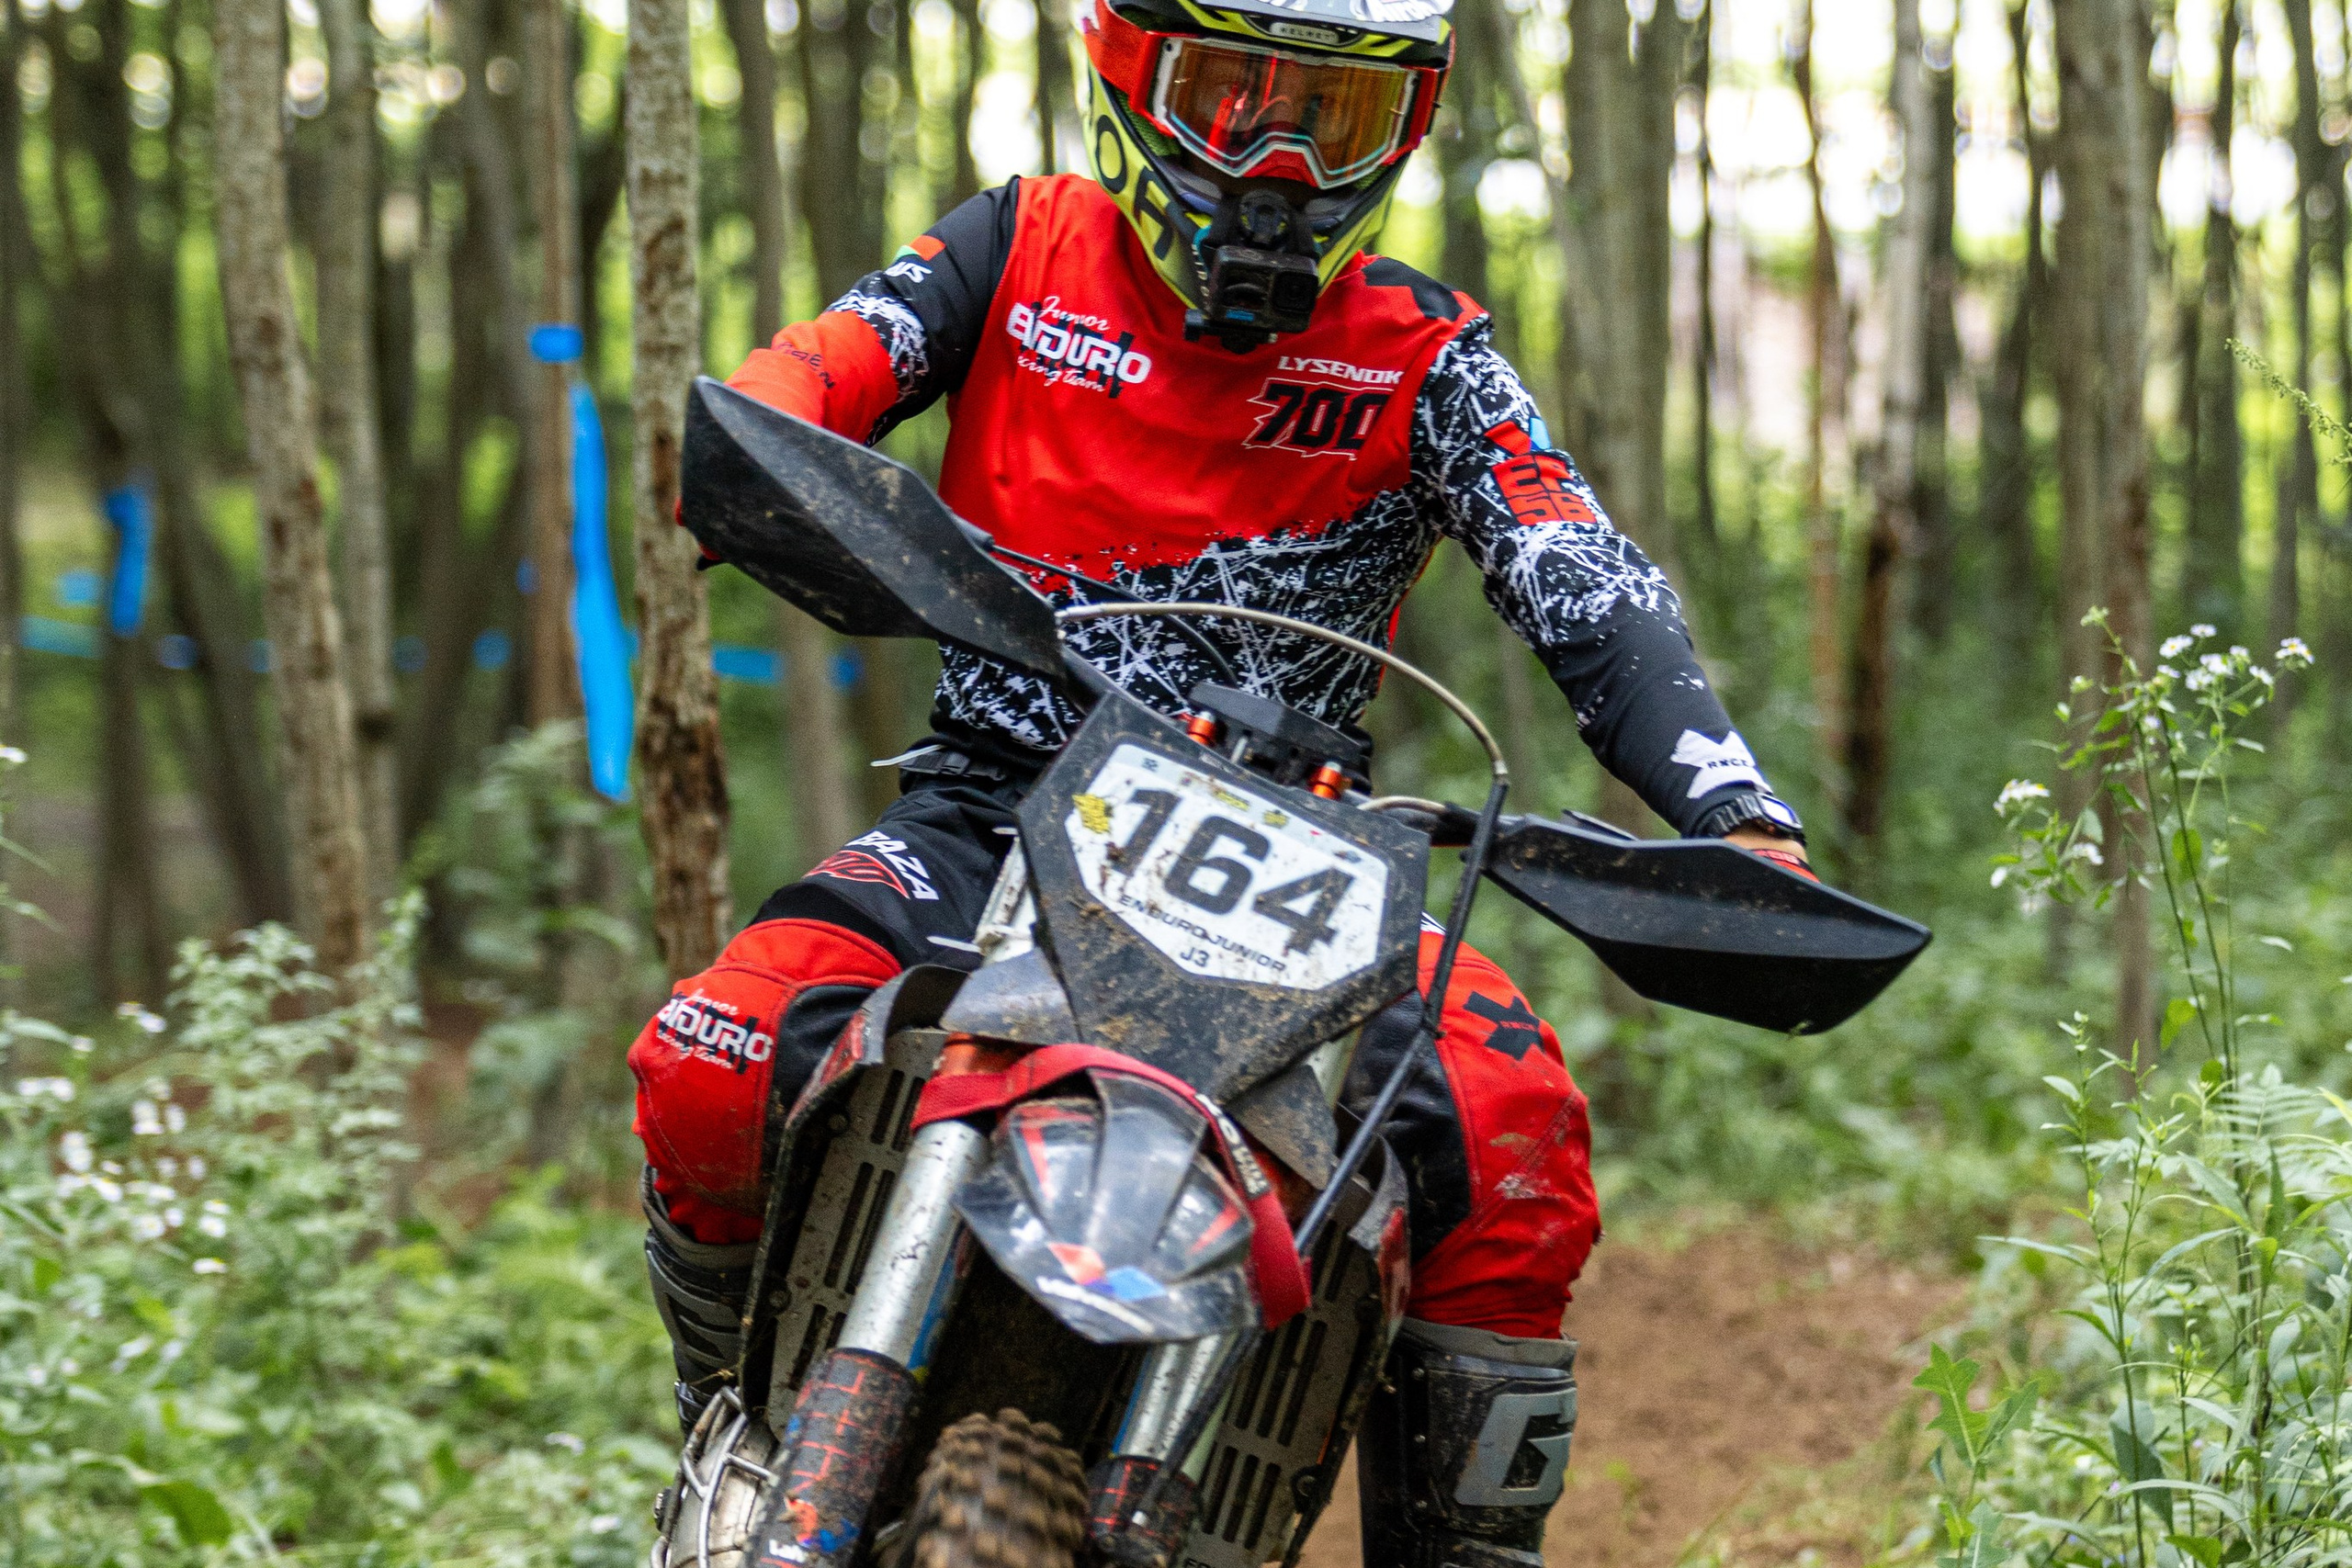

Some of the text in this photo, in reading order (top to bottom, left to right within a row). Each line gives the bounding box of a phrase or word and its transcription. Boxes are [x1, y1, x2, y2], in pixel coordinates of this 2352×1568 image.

[1277, 355, 1405, 385] LYSENOK
[1253, 382, 1393, 450] 700
[1110, 787, 1356, 956] 164
[1180, 946, 1210, 968] J3
